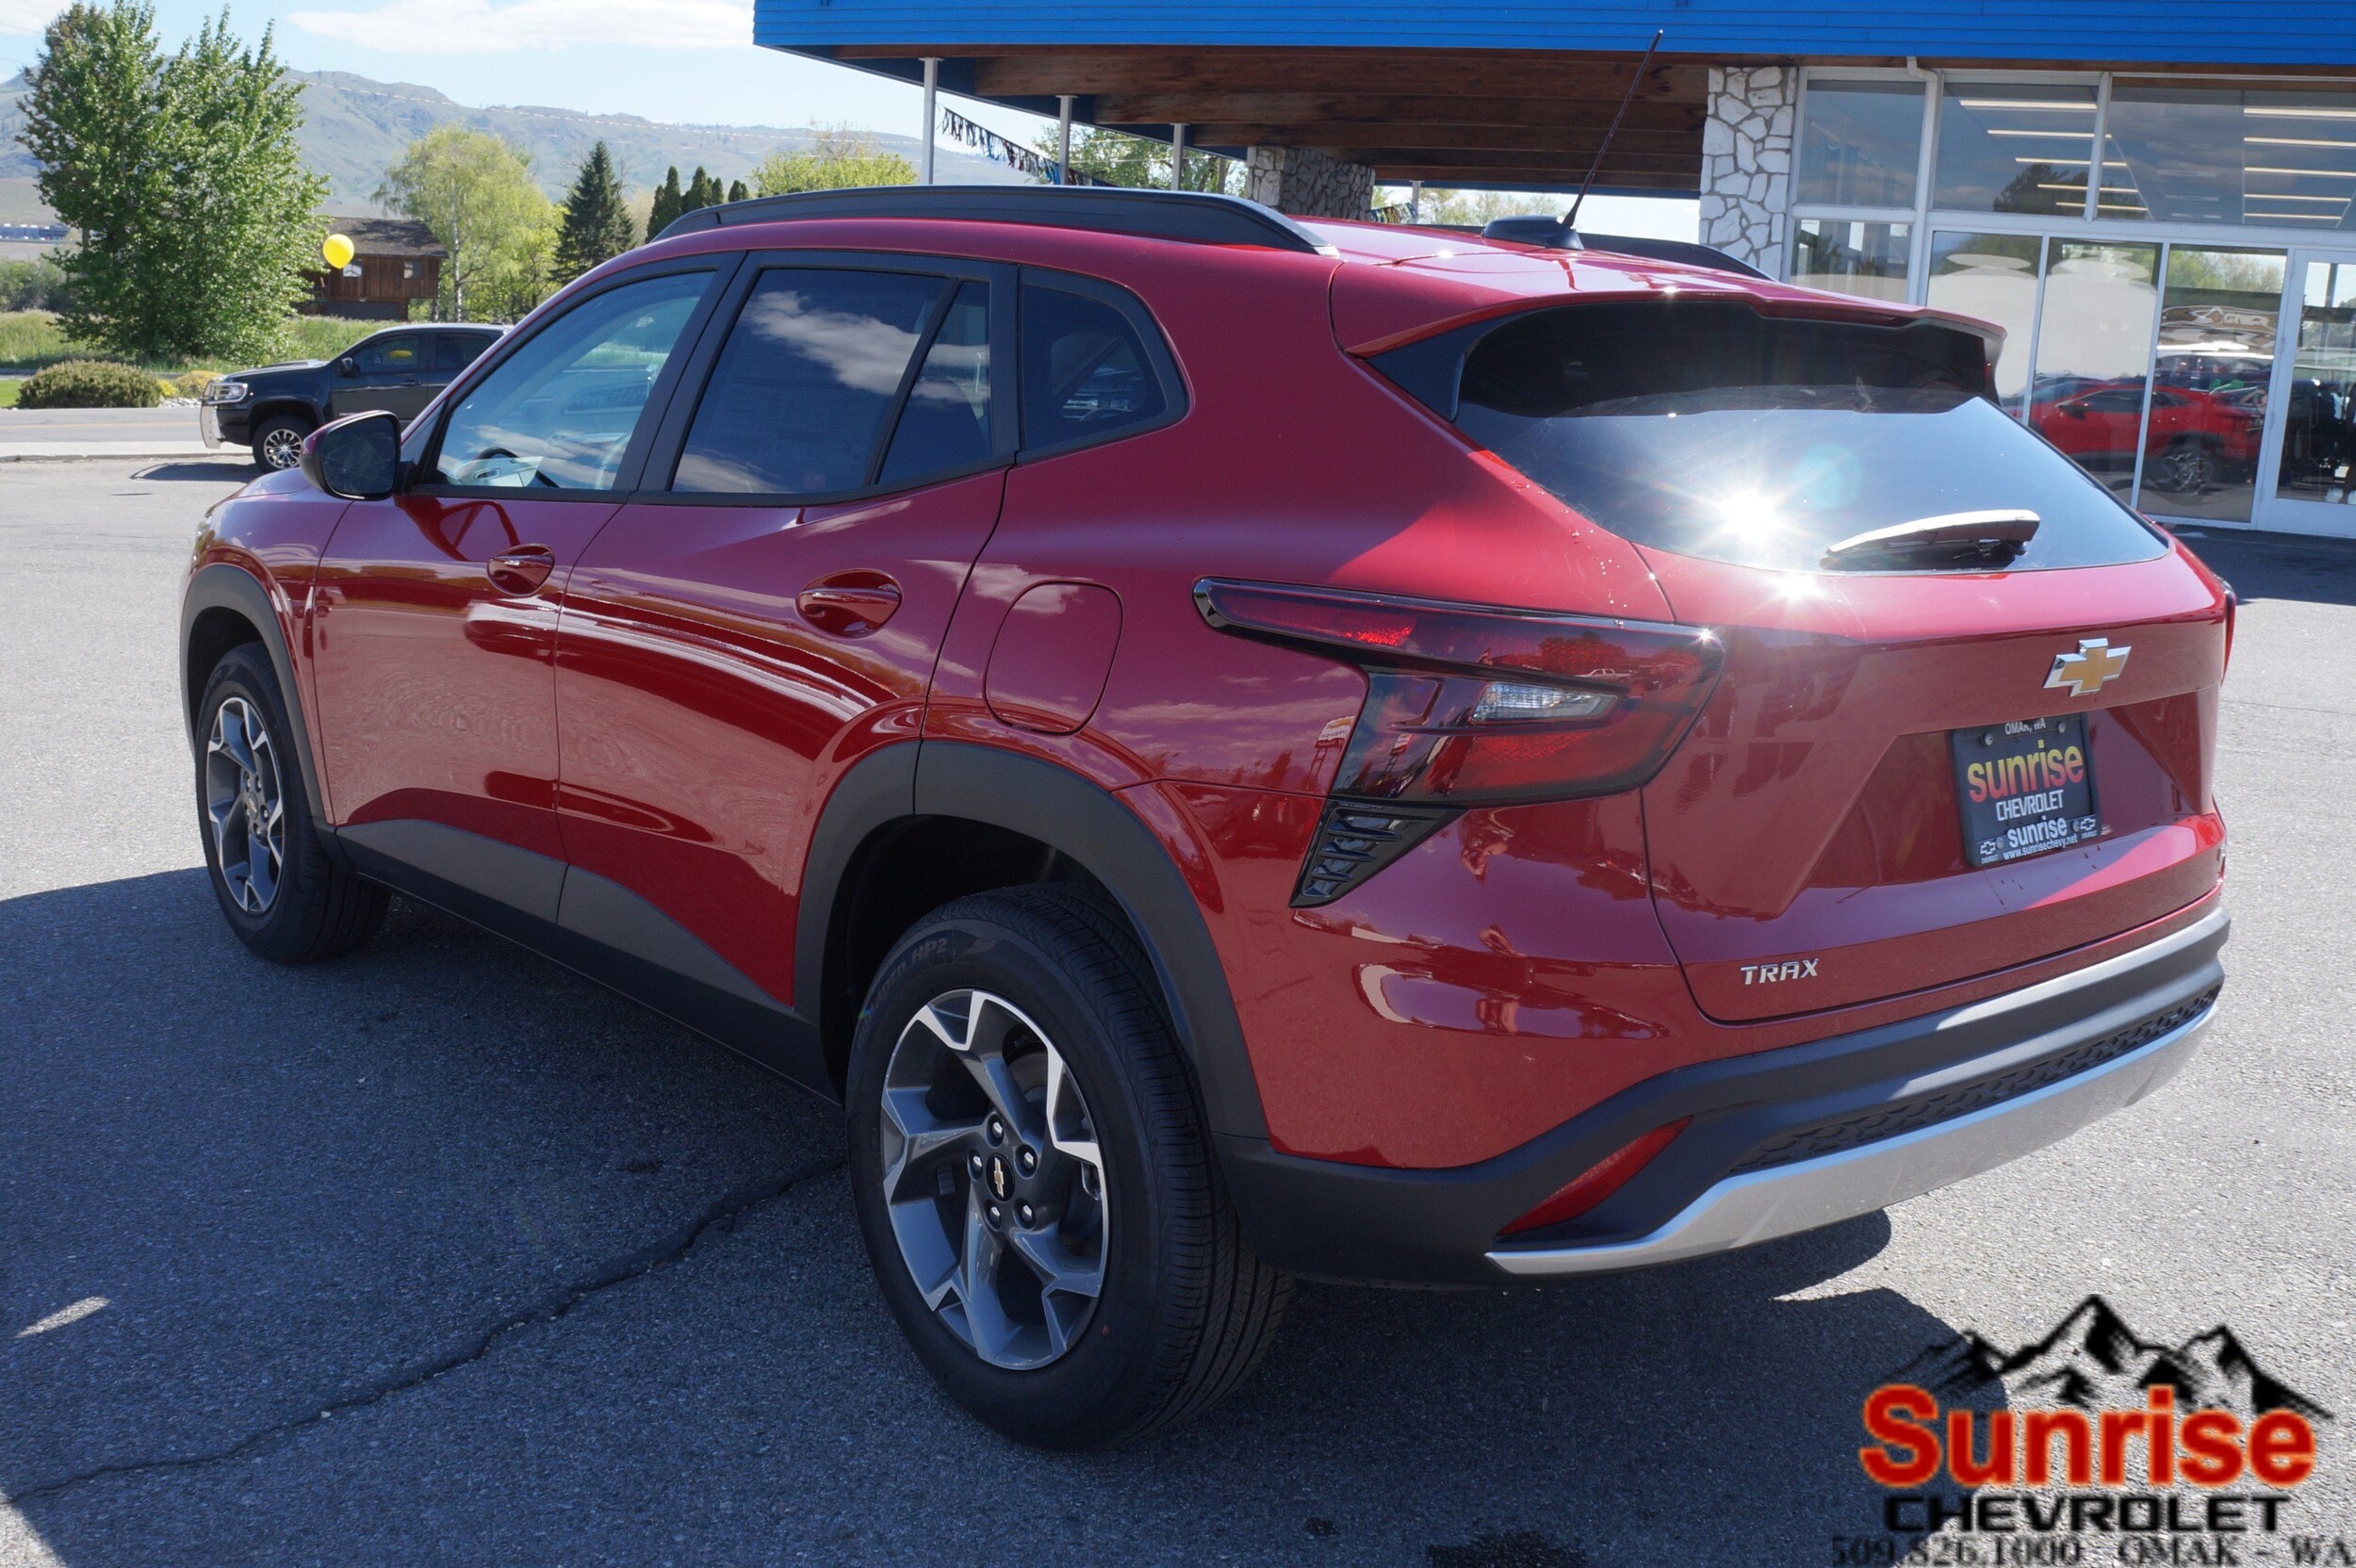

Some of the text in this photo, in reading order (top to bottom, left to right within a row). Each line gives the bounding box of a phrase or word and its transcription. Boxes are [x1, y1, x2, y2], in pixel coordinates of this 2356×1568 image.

[1967, 739, 2085, 803] sunrise
[1995, 790, 2065, 822] CHEVROLET
[2002, 833, 2079, 860] www.sunrisechevy.net
[2006, 815, 2069, 848] sunrise
[911, 939, 949, 963] HP2
[1740, 957, 1820, 986] TRAX
